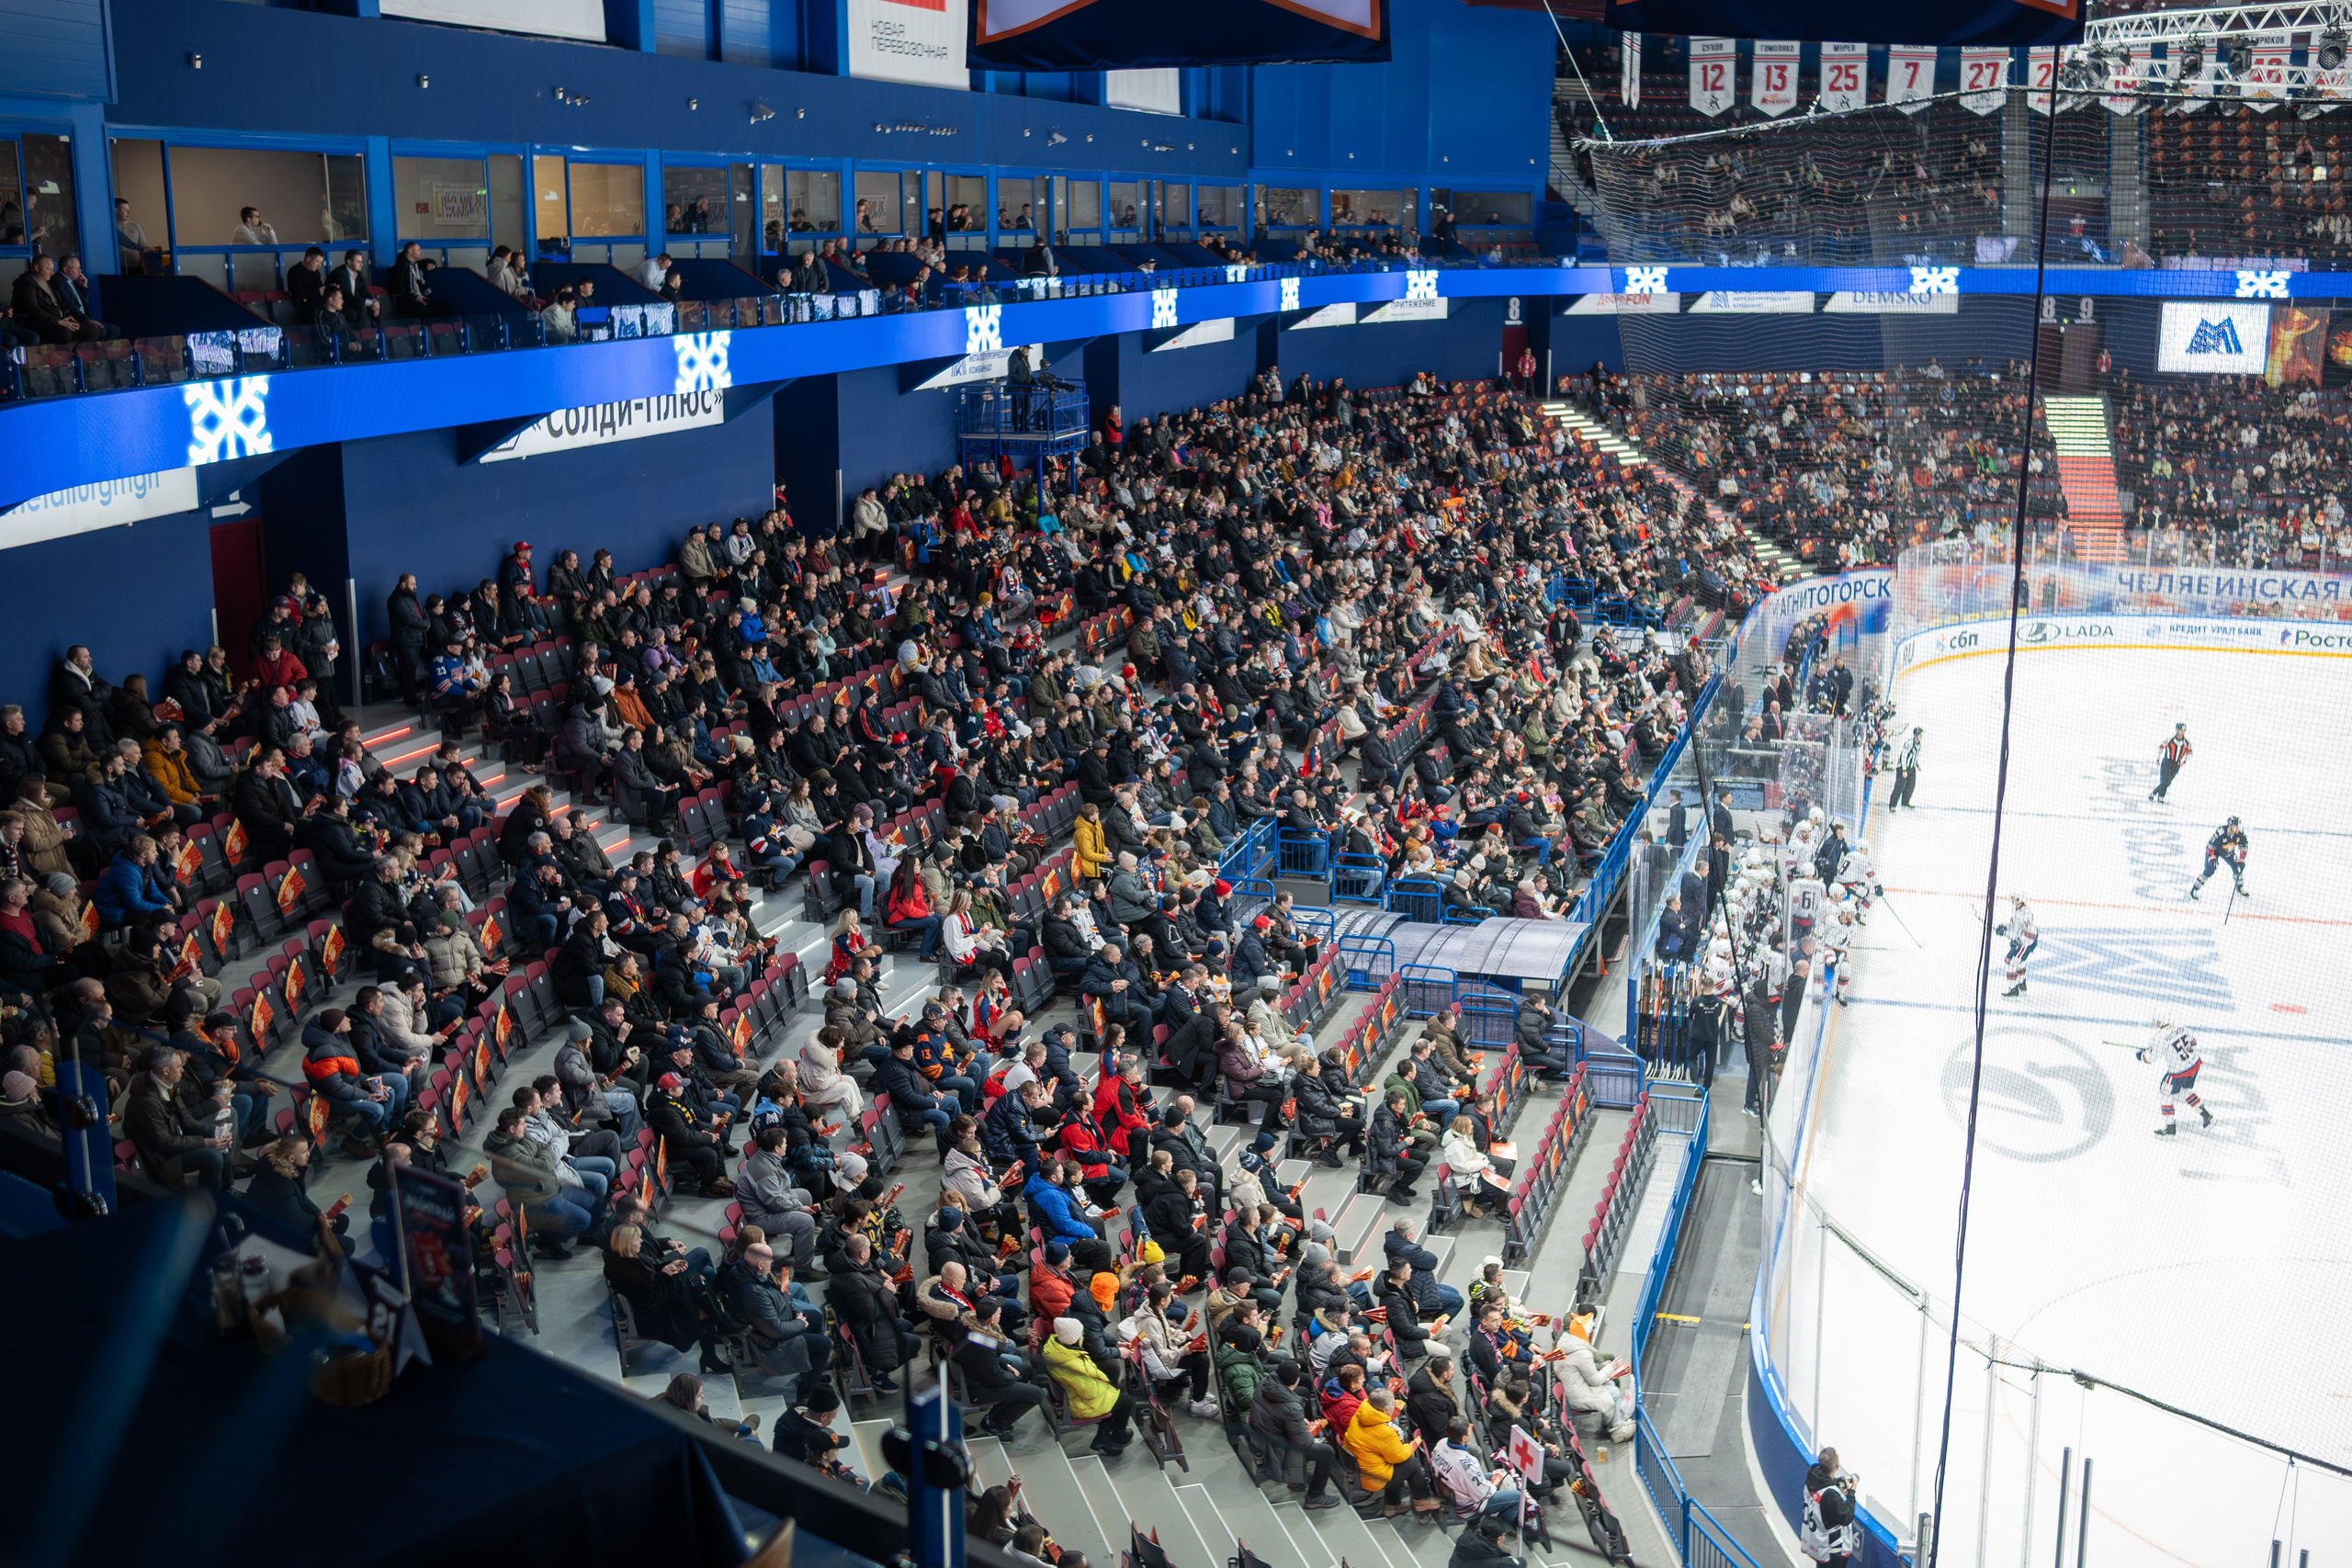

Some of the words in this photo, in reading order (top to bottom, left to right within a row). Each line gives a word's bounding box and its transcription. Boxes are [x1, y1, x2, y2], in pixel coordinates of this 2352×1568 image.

[871, 20, 905, 37] НОВАЯ
[871, 36, 948, 61] ПЕРЕВОЗОЧНАЯ
[1702, 64, 1724, 91] 12
[1766, 65, 1787, 91] 13
[1829, 65, 1858, 91] 25
[1905, 62, 1919, 89] 7
[1968, 62, 1999, 90] 27
[1509, 297, 1521, 320] 8
[2043, 297, 2056, 320] 8
[2080, 297, 2094, 319] 9
[2118, 572, 2340, 601] ЧЕЛЯБИНСКАЯ
[1950, 630, 1978, 649] сбп
[2066, 626, 2114, 637] LADA
[2169, 624, 2207, 636] КРЕДИТ
[2211, 625, 2235, 637] УРАЛ
[2237, 627, 2262, 638] БАНК
[436, 666, 447, 676] 23
[921, 1048, 932, 1060] 13
